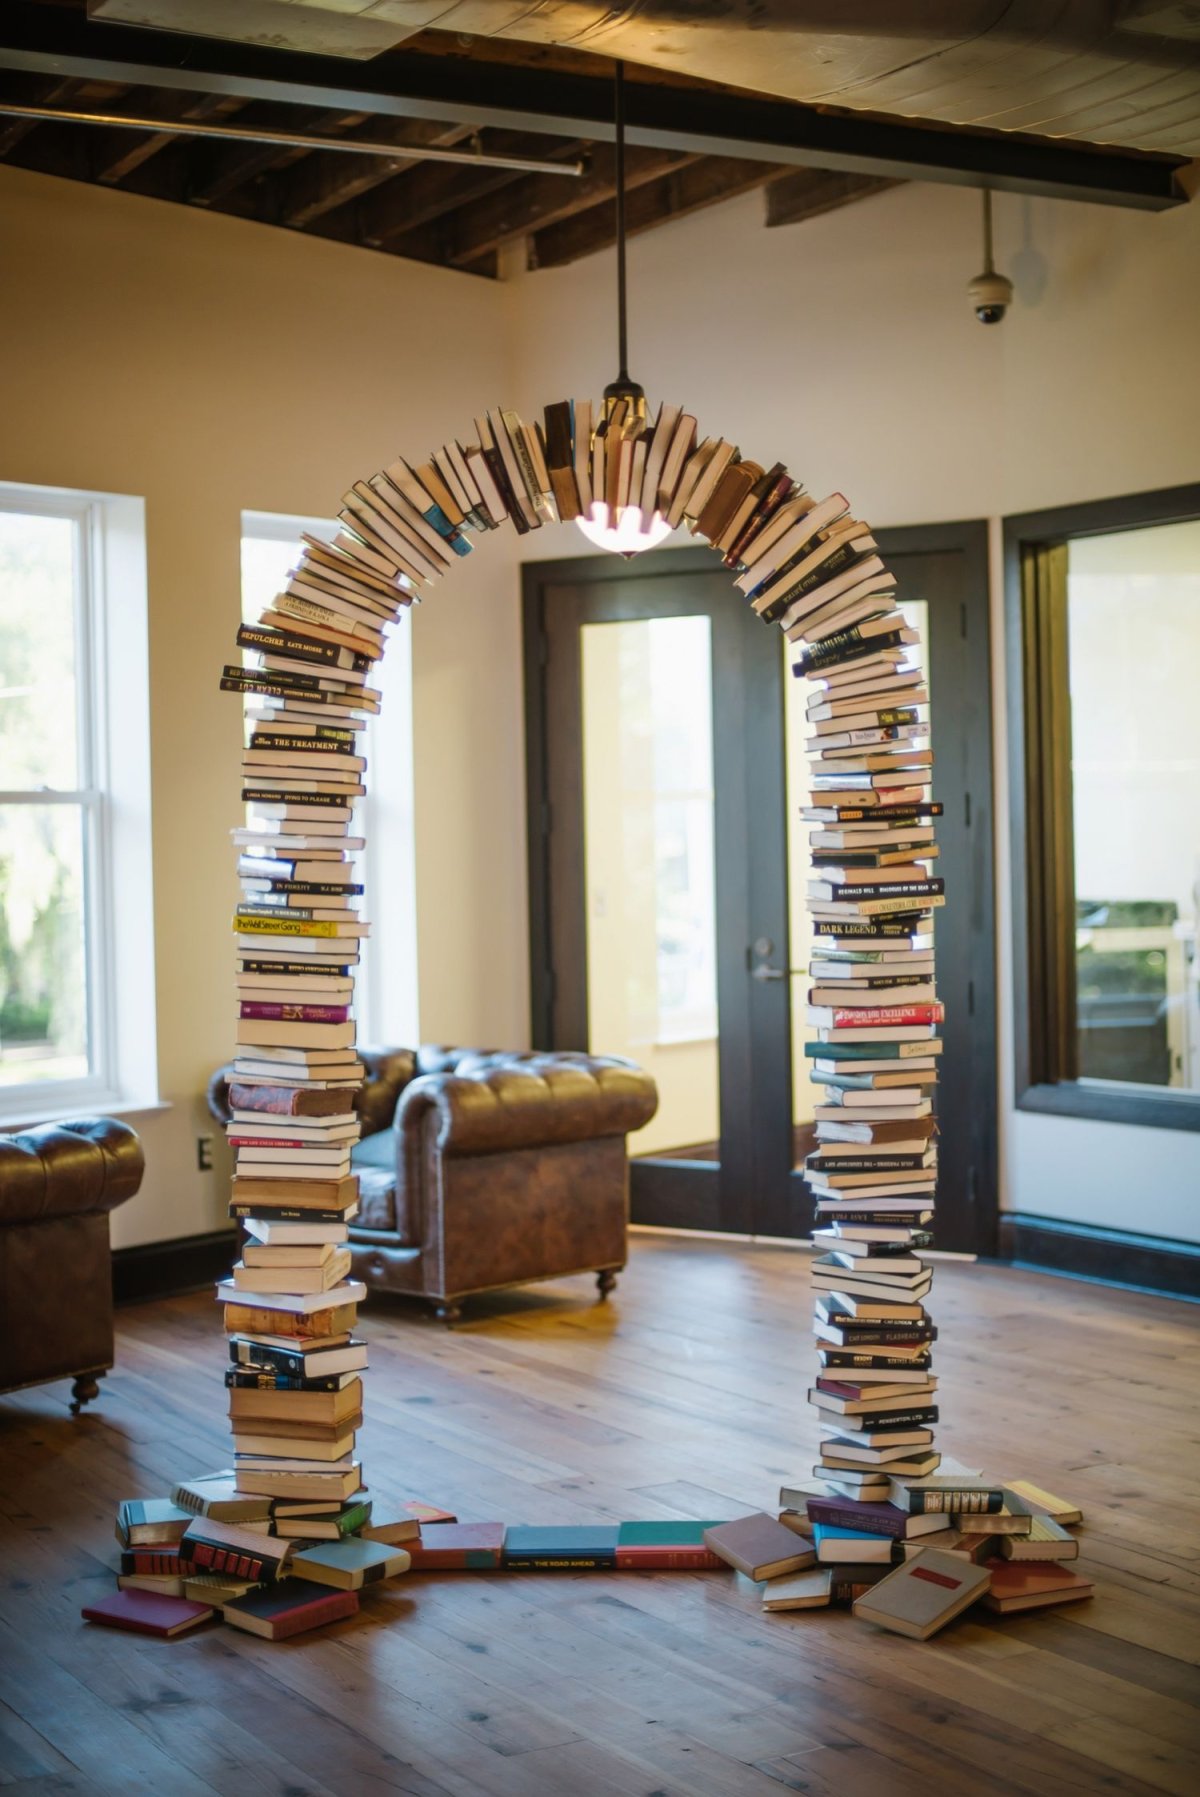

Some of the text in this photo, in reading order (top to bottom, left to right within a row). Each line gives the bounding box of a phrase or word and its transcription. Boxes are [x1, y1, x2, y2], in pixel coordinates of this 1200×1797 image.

[241, 632, 284, 646] SEPULCHRE
[257, 685, 281, 694] CLEAN
[292, 740, 338, 750] TREATMENT
[820, 924, 842, 934] DARK
[845, 924, 876, 934] LEGEND
[881, 1008, 916, 1017] EXCELLENCE
